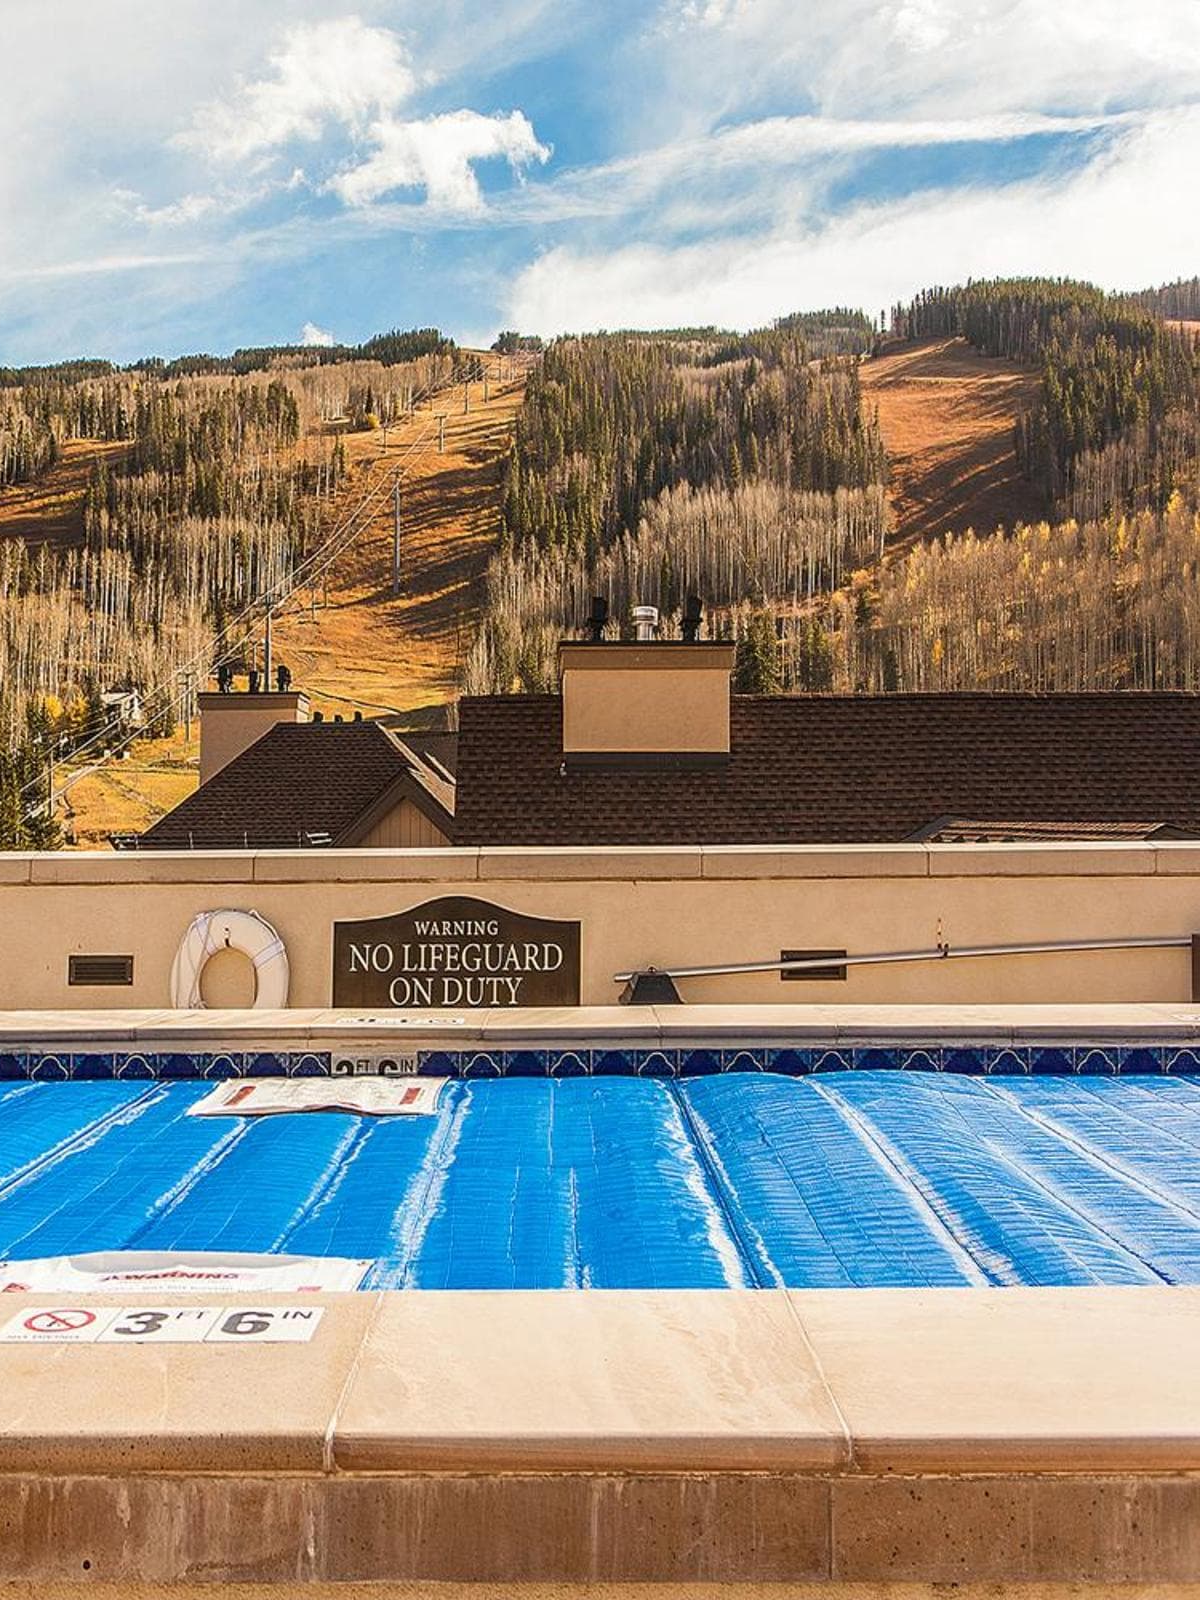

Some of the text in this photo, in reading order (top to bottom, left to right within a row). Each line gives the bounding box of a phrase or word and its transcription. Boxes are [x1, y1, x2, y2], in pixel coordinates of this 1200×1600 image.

[414, 921, 499, 936] WARNING
[349, 943, 564, 972] NO LIFEGUARD
[389, 977, 523, 1006] ON DUTY
[356, 1059, 370, 1072] FT
[401, 1059, 414, 1073] IN
[124, 1270, 239, 1281] WARNING
[114, 1311, 169, 1335] 3
[221, 1311, 275, 1335] 6
[282, 1311, 313, 1320] IN
